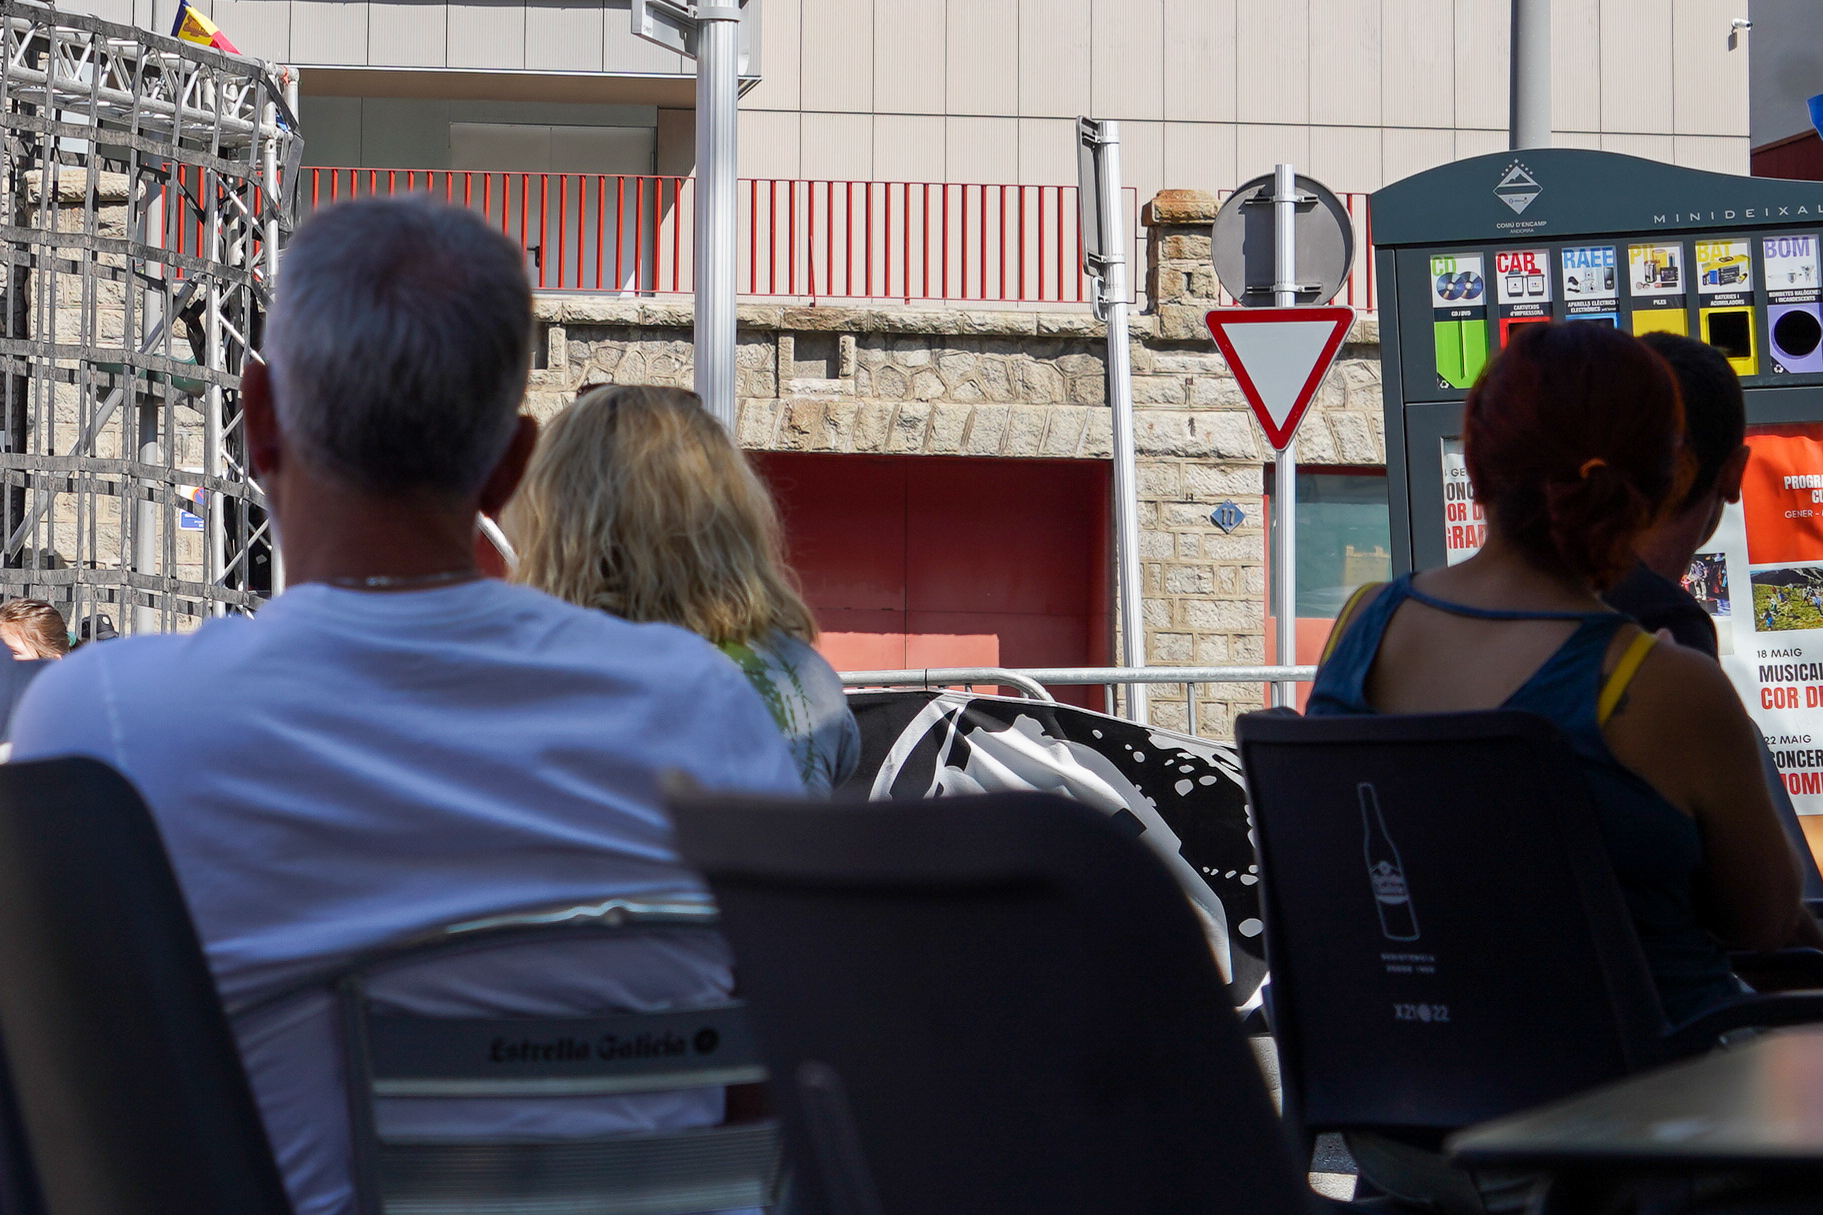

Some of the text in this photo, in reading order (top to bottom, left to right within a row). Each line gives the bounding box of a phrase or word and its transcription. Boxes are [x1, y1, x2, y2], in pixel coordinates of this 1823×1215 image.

[1563, 247, 1614, 269] RAEE
[1696, 241, 1733, 263] BAT
[1764, 237, 1810, 259] BOM
[1431, 256, 1457, 276] CD
[1783, 474, 1823, 490] PROGR
[1784, 509, 1813, 518] GENER
[1757, 648, 1802, 658] 18 MAIG
[1761, 687, 1799, 710] COR
[1765, 735, 1811, 745] 22 MAIG
[489, 1033, 686, 1064] Estrella Galicia
